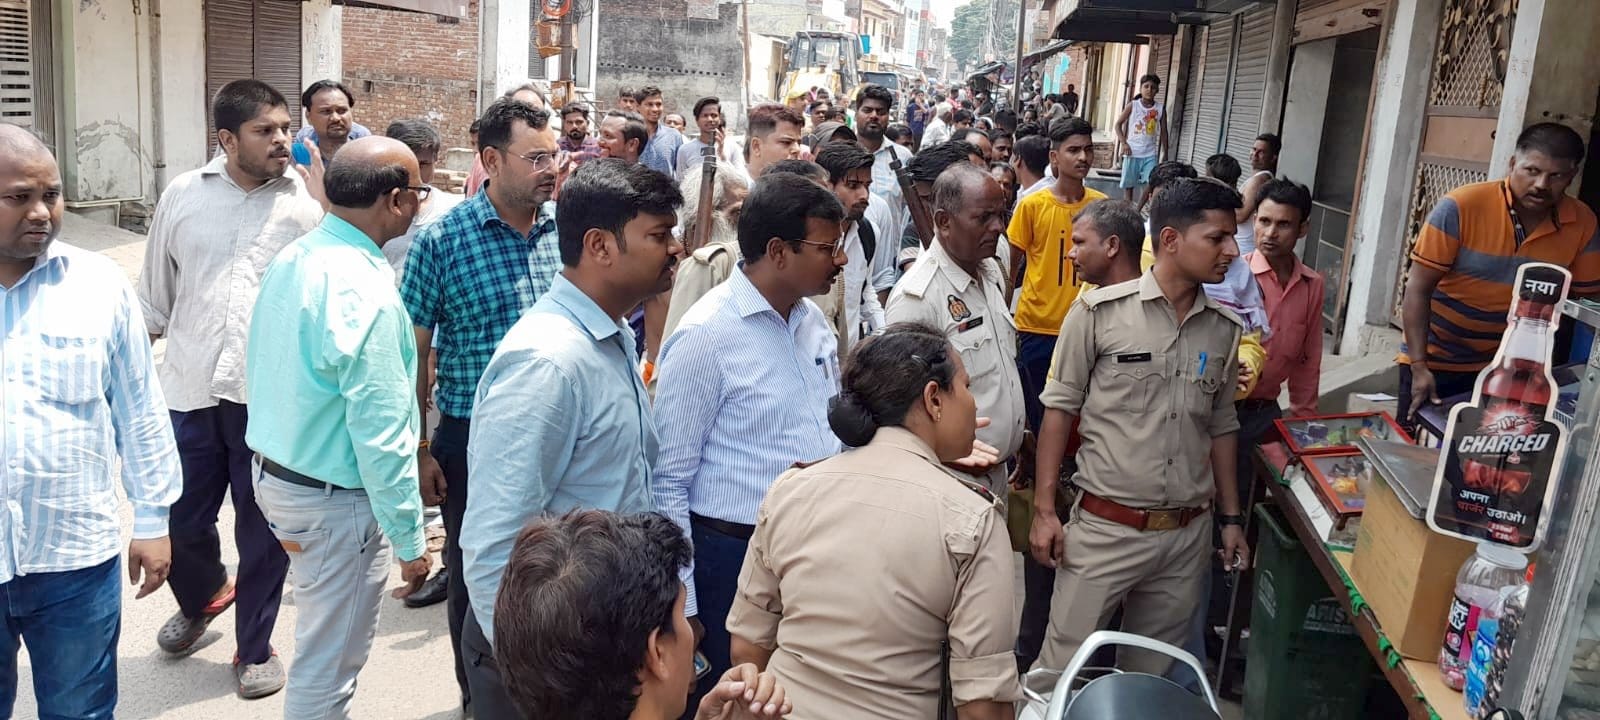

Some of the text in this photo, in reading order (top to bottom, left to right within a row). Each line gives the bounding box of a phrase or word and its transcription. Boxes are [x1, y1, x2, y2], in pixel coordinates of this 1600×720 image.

[1524, 279, 1557, 296] नया
[1458, 433, 1551, 453] CHARGED
[1459, 489, 1490, 504] अपना
